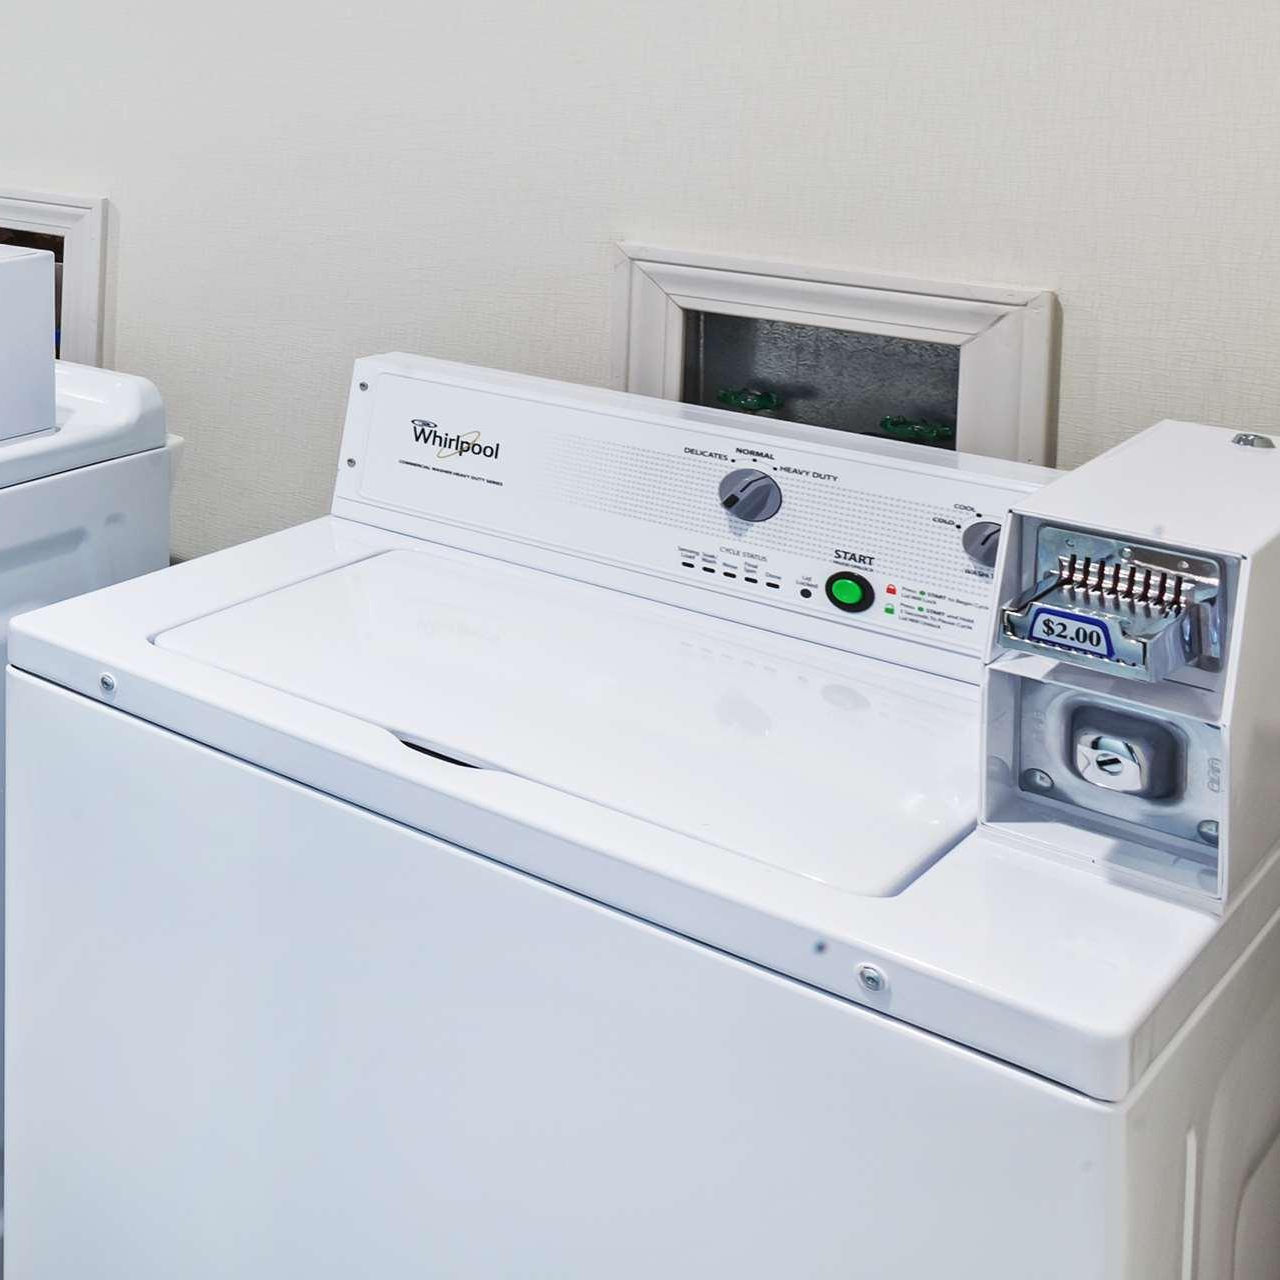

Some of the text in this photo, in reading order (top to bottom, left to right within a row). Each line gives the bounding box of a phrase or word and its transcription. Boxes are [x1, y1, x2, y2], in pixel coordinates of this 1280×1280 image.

[413, 426, 500, 459] Whirlpool
[684, 447, 728, 461] DELICATES
[735, 447, 775, 460] NORMAL
[779, 466, 839, 482] HEAVY DUTY
[932, 517, 955, 526] COLD
[834, 549, 875, 566] START
[1042, 618, 1101, 647] $2.00
